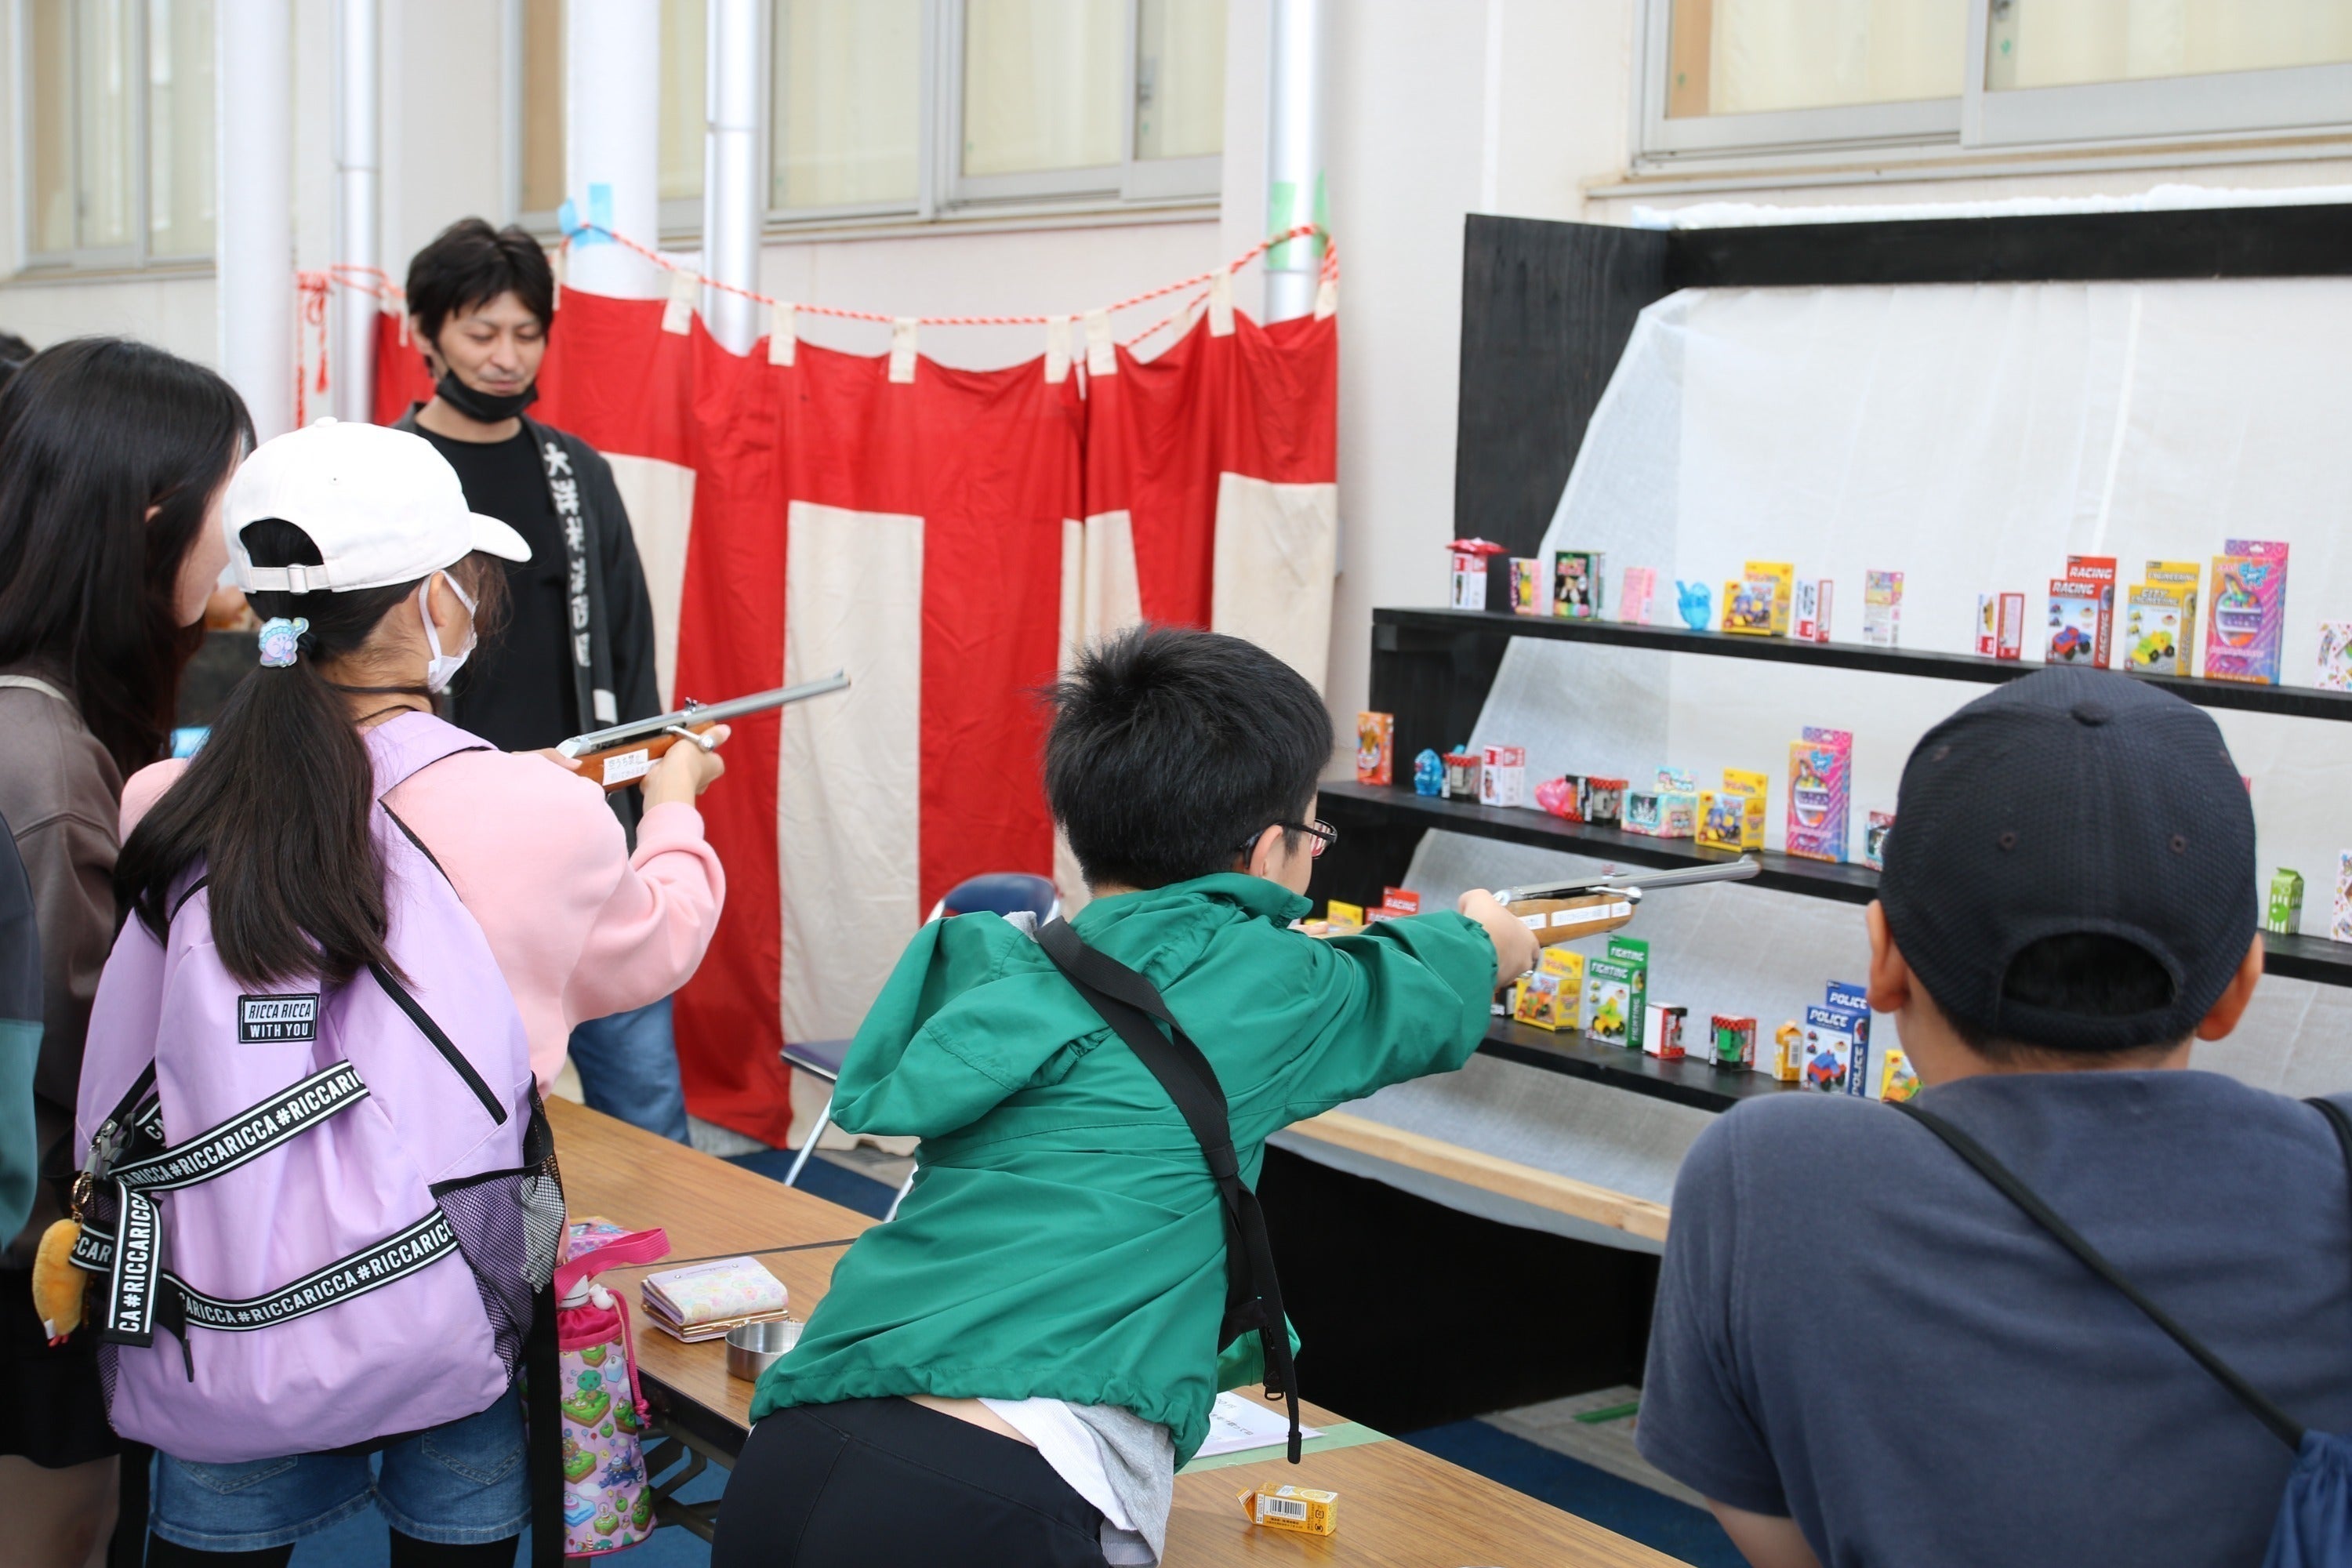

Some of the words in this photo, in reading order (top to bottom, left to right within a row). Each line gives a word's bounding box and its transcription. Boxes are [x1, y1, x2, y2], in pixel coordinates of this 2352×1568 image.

[2069, 566, 2113, 579] RACING
[2052, 581, 2095, 595] RACING
[1591, 961, 1628, 979] FIGHTING
[1830, 992, 1867, 1009] POLICE
[249, 1004, 279, 1019] RICCA
[281, 1003, 311, 1018] RICCA
[1809, 1009, 1848, 1027] POLICE
[249, 1024, 281, 1038] WITH
[285, 1022, 309, 1036] YOU
[1852, 1047, 1863, 1095] POLICE
